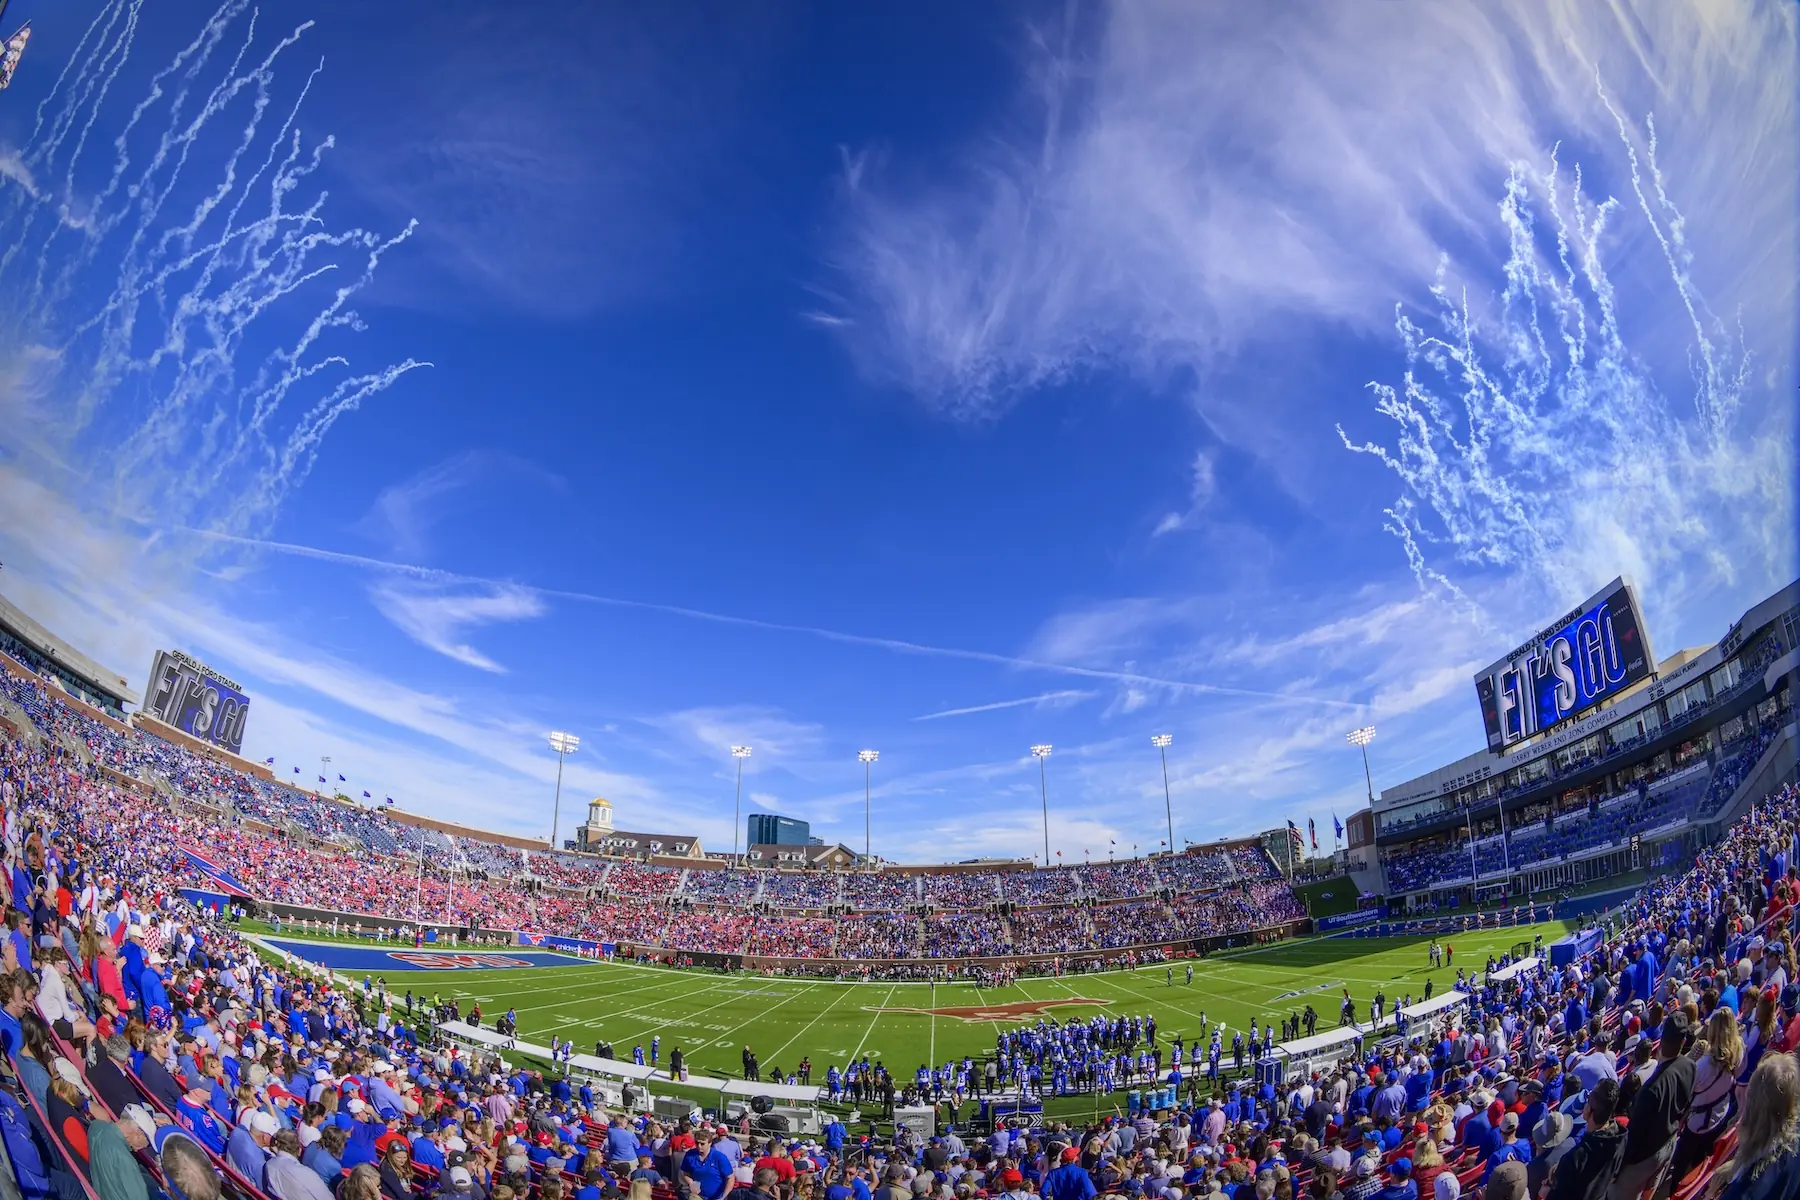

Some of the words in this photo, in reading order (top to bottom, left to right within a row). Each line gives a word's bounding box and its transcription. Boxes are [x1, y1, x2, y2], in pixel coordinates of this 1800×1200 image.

[1506, 643, 1531, 662] GERALD
[1537, 627, 1555, 643] FORD
[1554, 607, 1583, 631] STADIUM
[172, 650, 197, 669] GERALD
[201, 664, 218, 681] FORD
[218, 675, 242, 692] STADIUM
[1489, 636, 1578, 747] ET'S
[1577, 603, 1627, 698] GO
[1663, 669, 1682, 686] FOOTBALL
[1682, 660, 1699, 674] PLAYOFF
[213, 697, 249, 747] GO
[1511, 752, 1532, 763] GARRY
[1531, 742, 1553, 756] WEBER
[1554, 734, 1567, 746] END
[1568, 726, 1586, 738] ZONE
[1587, 708, 1619, 729] COMPLEX
